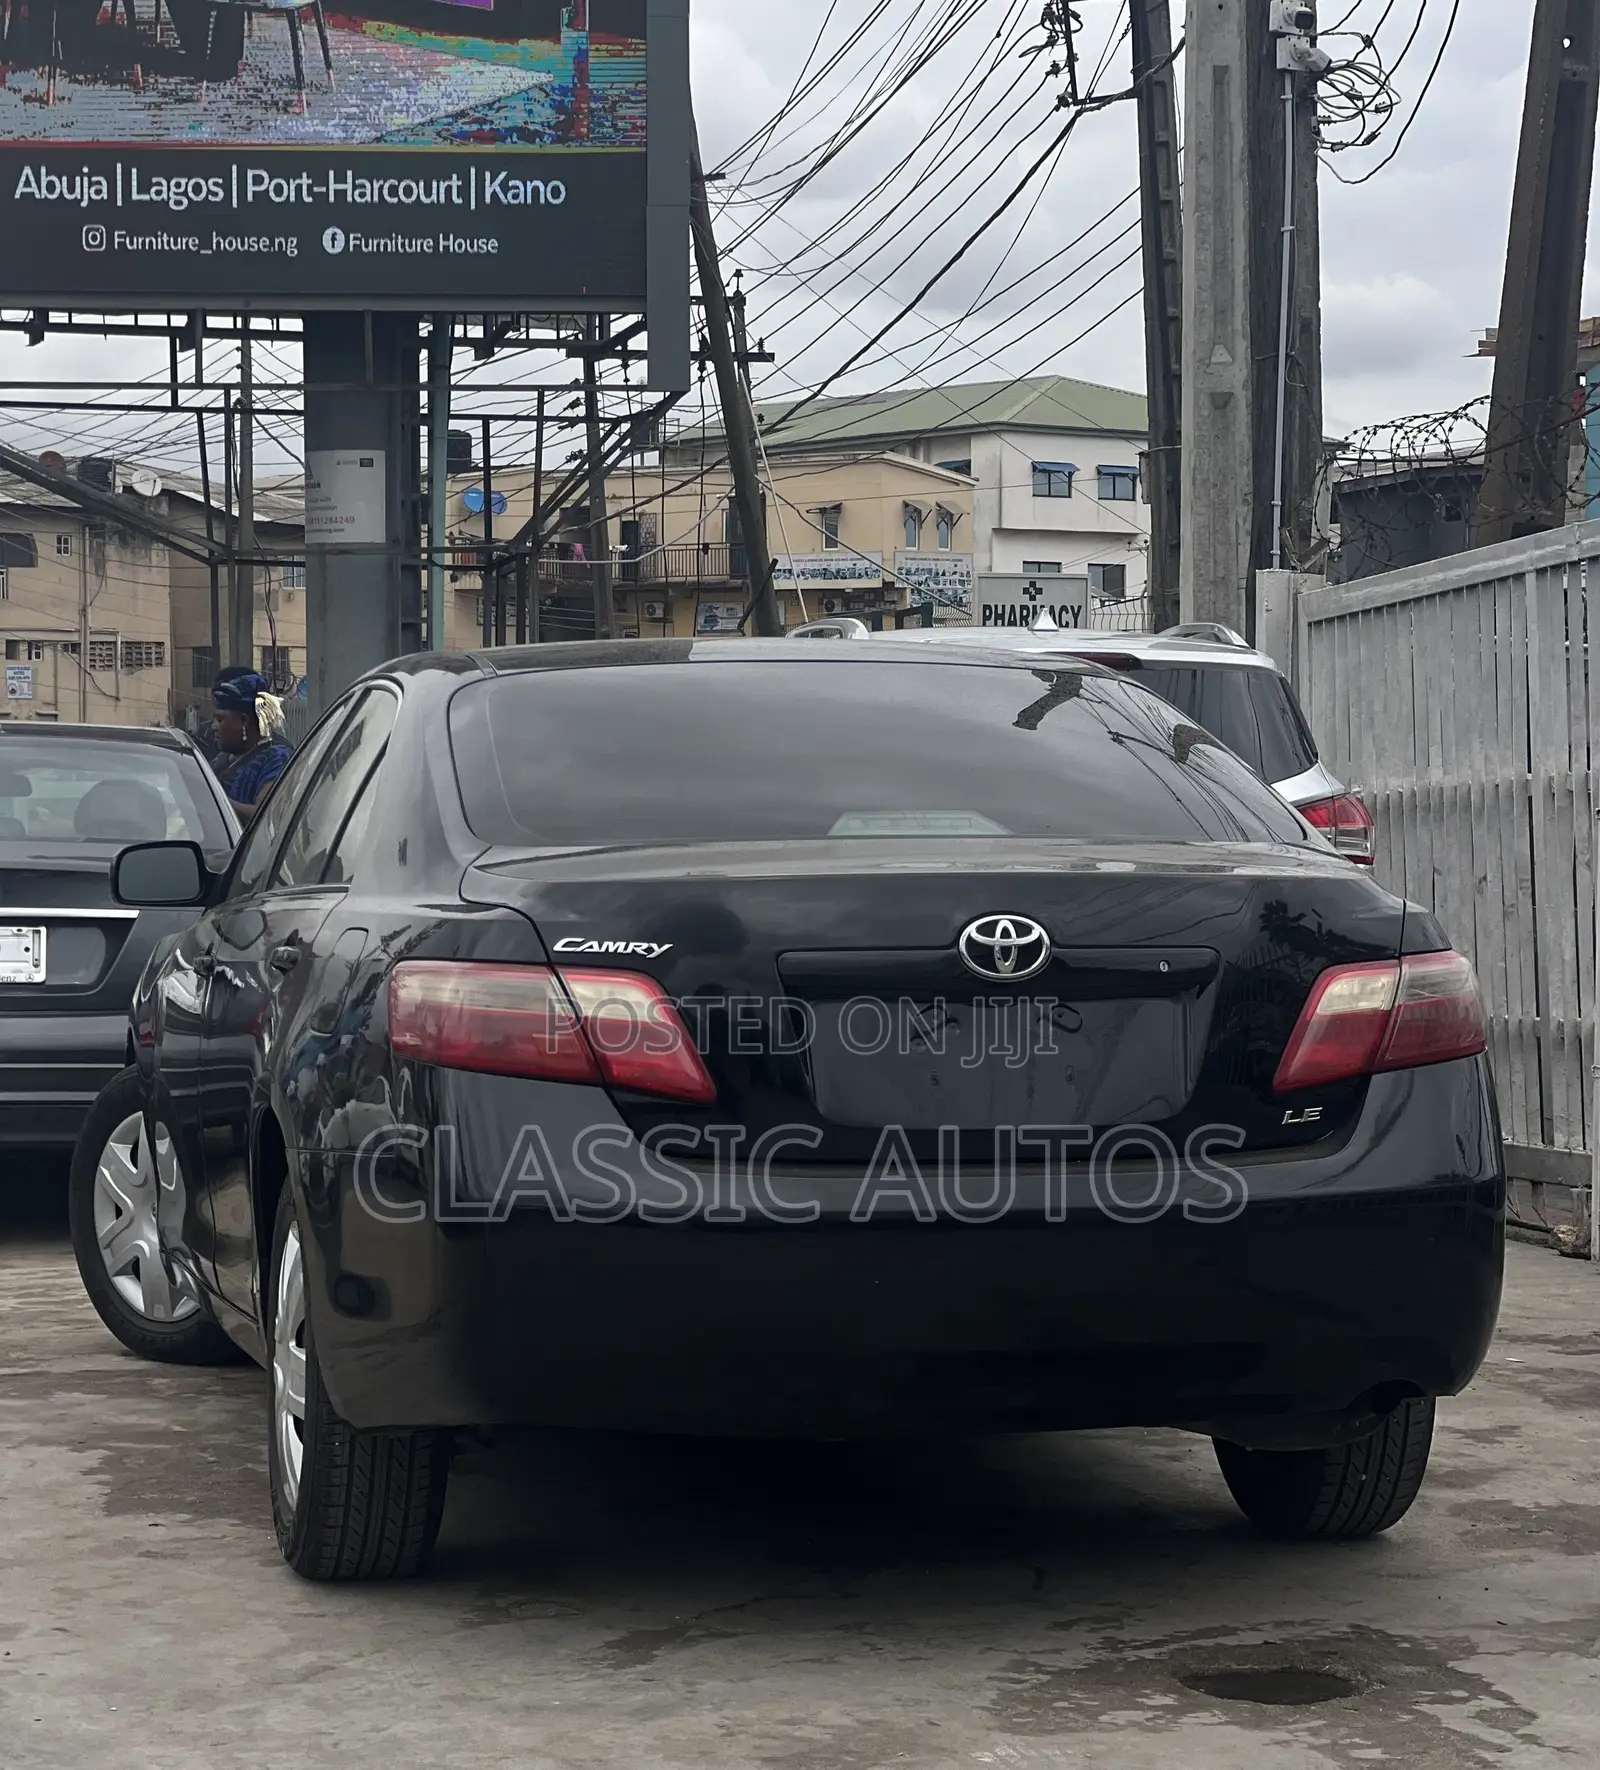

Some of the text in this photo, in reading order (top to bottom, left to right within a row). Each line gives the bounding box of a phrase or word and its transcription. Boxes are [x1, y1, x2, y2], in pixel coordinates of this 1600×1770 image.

[14, 165, 108, 208] Abuja
[131, 167, 225, 211] Lagos
[247, 168, 463, 205] Port-Harcourt
[484, 170, 566, 205] Kano
[114, 230, 298, 257] Furniture_house.ng
[349, 232, 434, 253] Furniture
[439, 233, 499, 254] House
[552, 937, 674, 959] CAMRY
[0, 975, 17, 983] enz
[1281, 1106, 1323, 1125] LE
